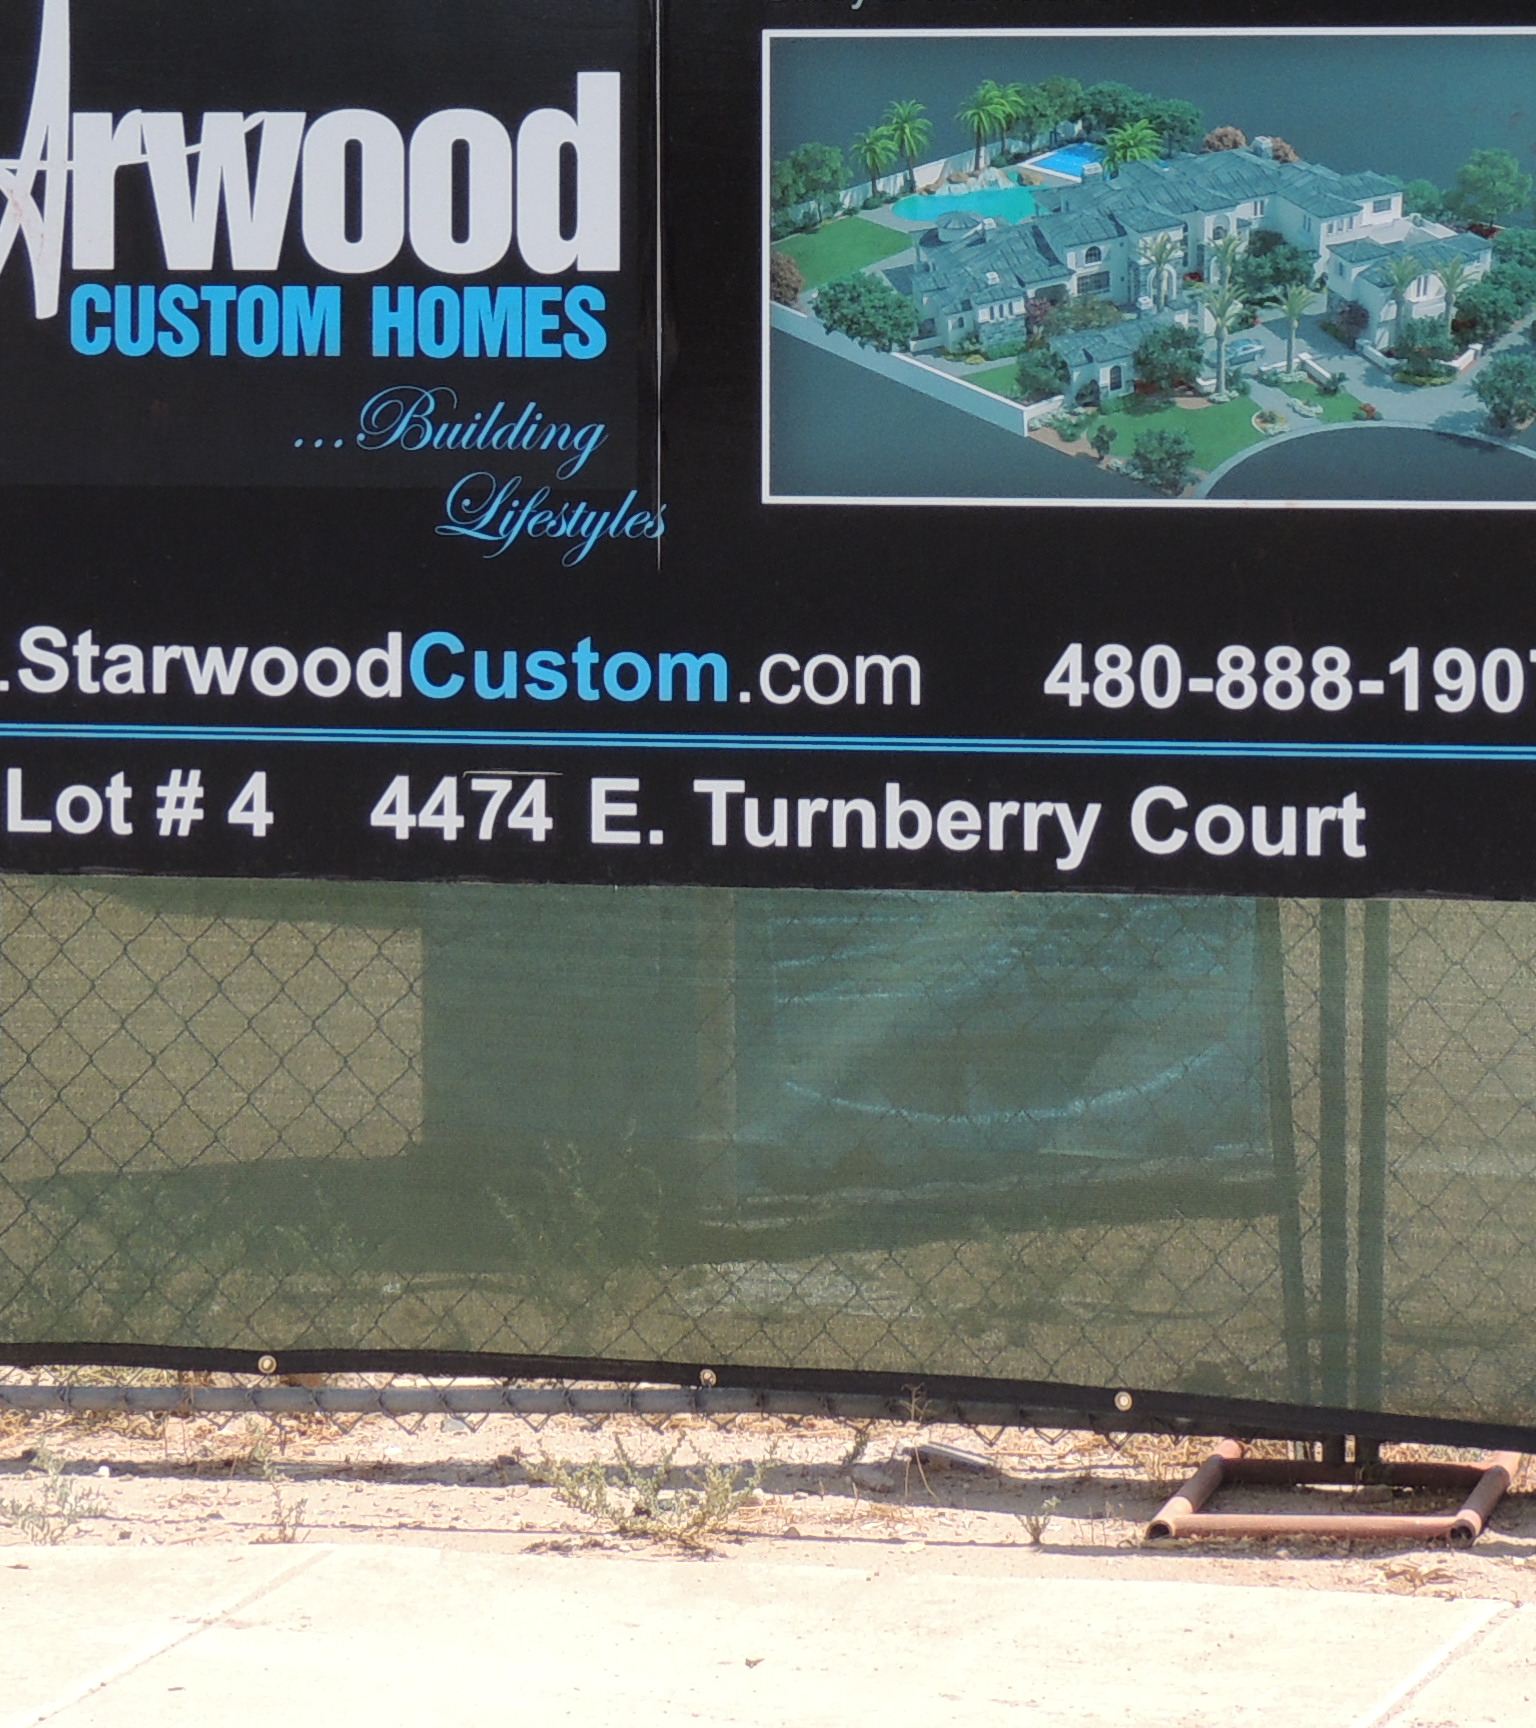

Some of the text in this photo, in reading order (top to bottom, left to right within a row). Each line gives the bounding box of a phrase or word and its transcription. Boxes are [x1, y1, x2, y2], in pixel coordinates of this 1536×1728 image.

[69, 283, 608, 360] CUSTOM HOMES
[435, 470, 666, 566] Lifestyles
[6, 768, 275, 837] Lot # 4
[370, 774, 1367, 871] 4474 E. Turnberry Court
